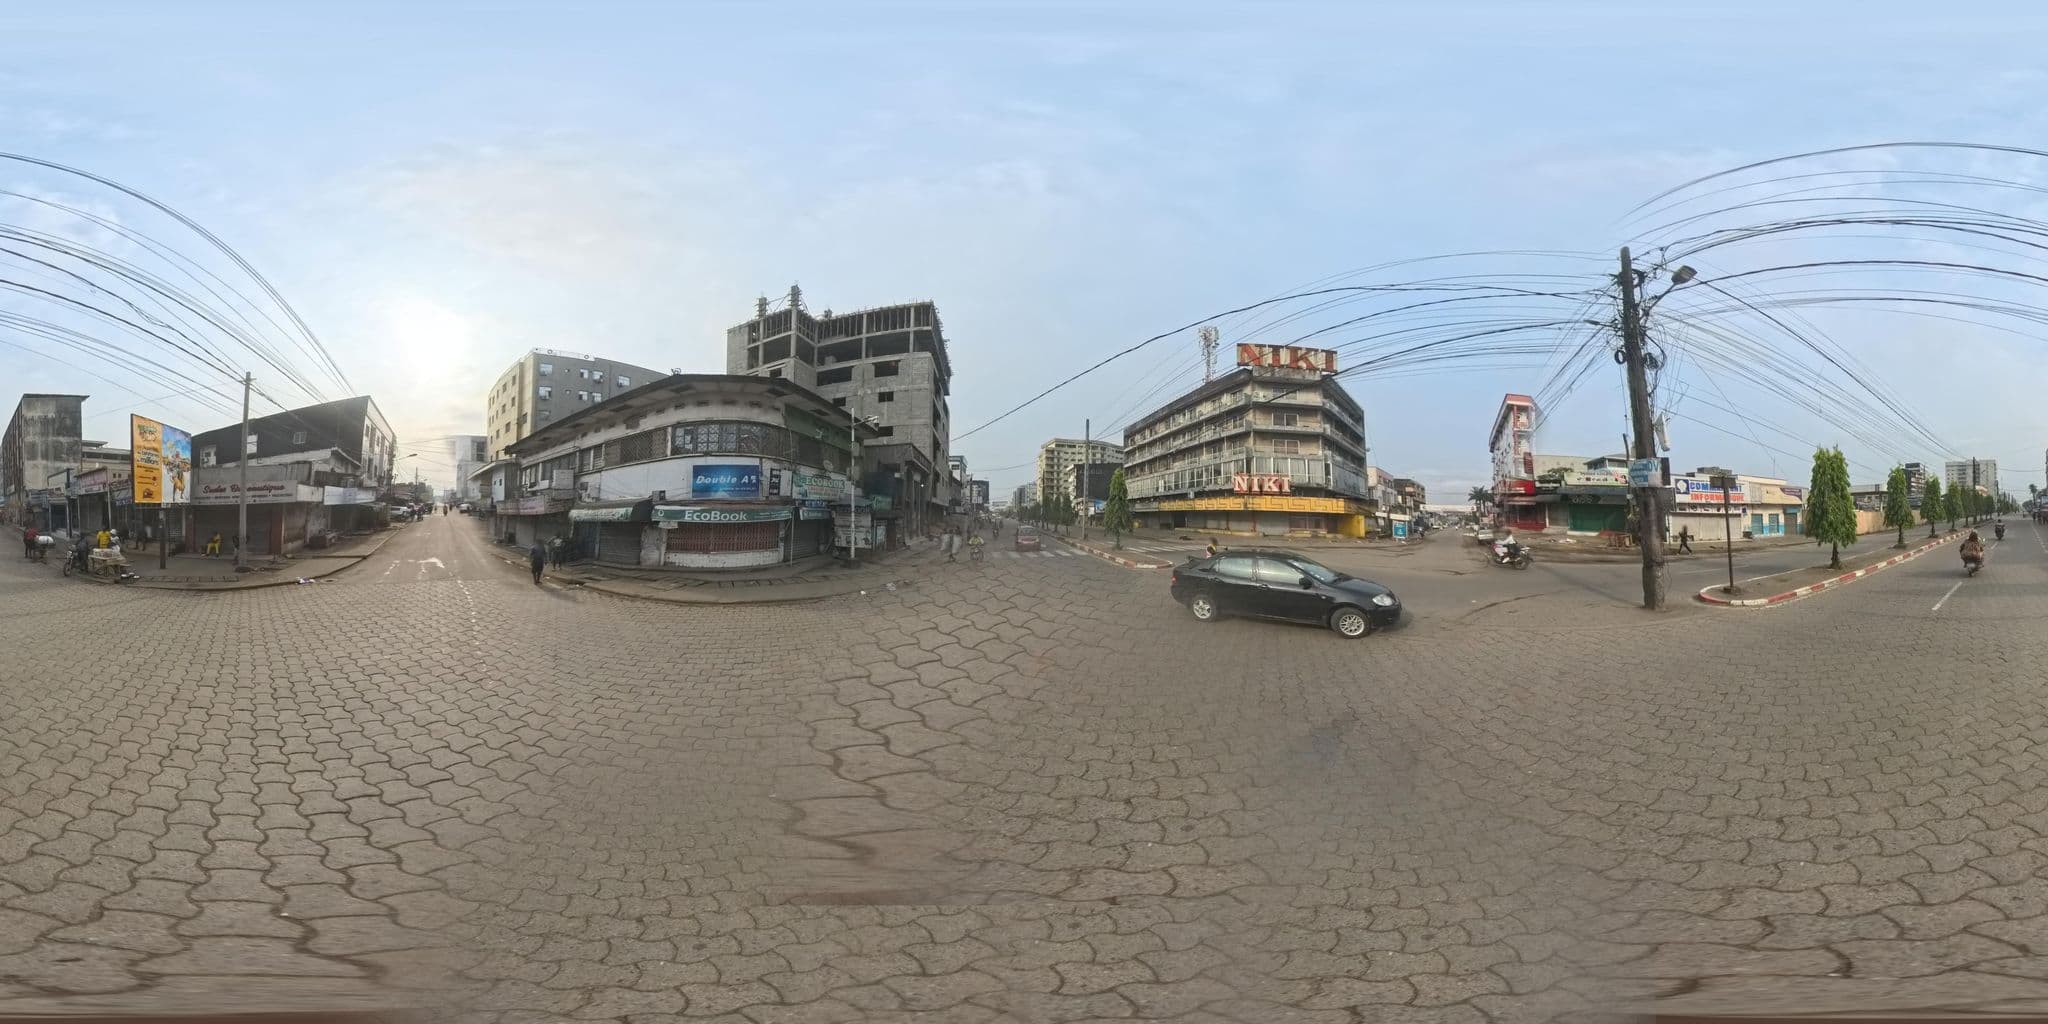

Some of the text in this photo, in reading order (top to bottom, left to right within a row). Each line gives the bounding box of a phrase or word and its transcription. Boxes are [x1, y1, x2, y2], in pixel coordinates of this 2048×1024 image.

[1240, 344, 1334, 371] NIKI
[696, 475, 737, 484] Double
[1233, 475, 1291, 492] NIKI
[684, 510, 748, 521] EcoBook
